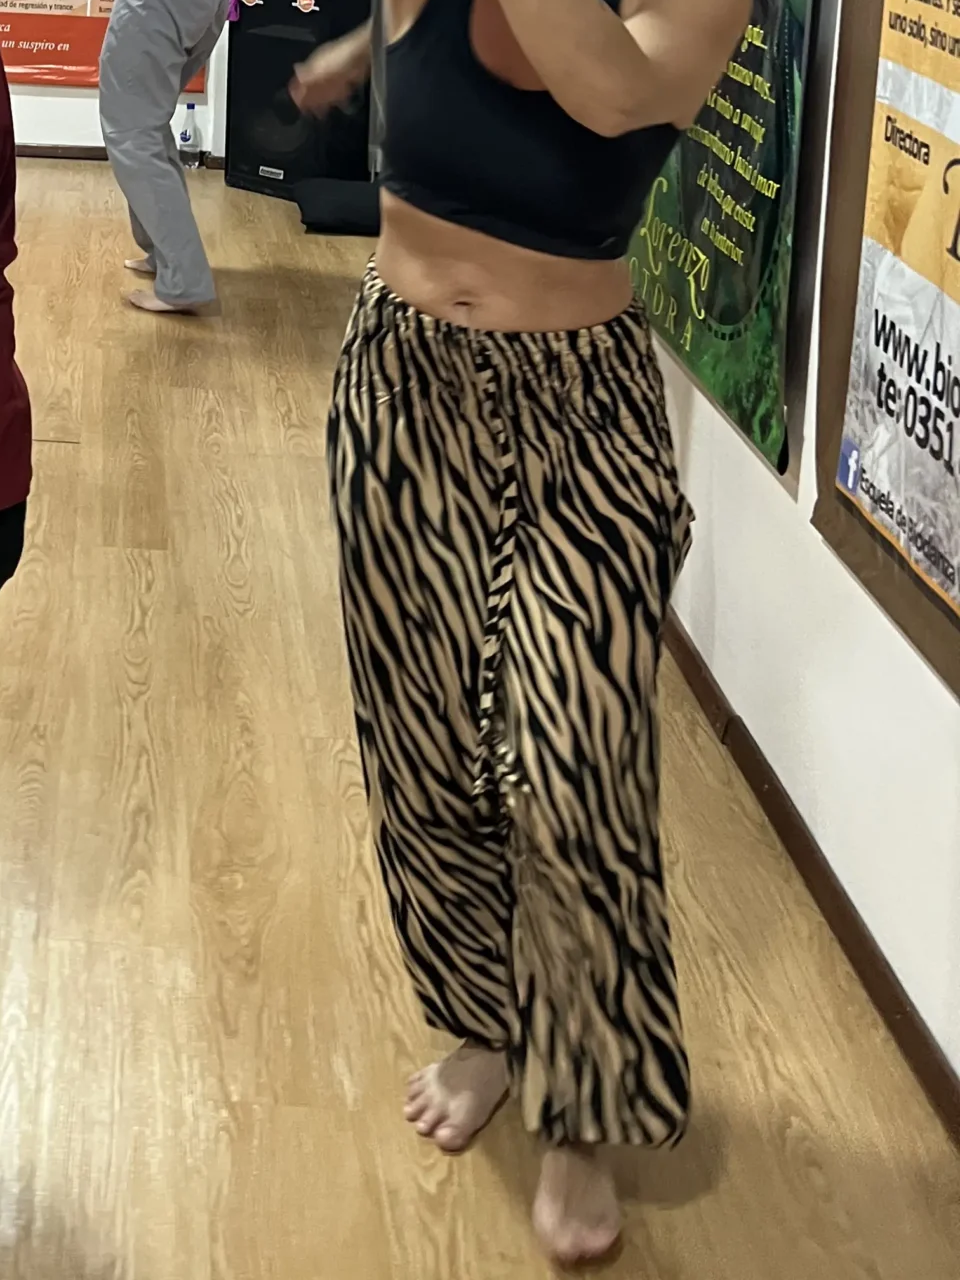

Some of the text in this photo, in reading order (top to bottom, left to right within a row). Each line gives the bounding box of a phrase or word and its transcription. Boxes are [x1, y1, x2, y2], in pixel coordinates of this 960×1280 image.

[8, 0, 18, 9] de
[18, 1, 48, 11] regresión
[53, 3, 74, 11] trance
[1, 39, 70, 54] un suspiro en
[889, 10, 947, 53] uno solo, sino
[883, 115, 931, 167] Directora
[640, 176, 711, 320] Lorenzo
[859, 467, 956, 585] Escuela de Biodanza
